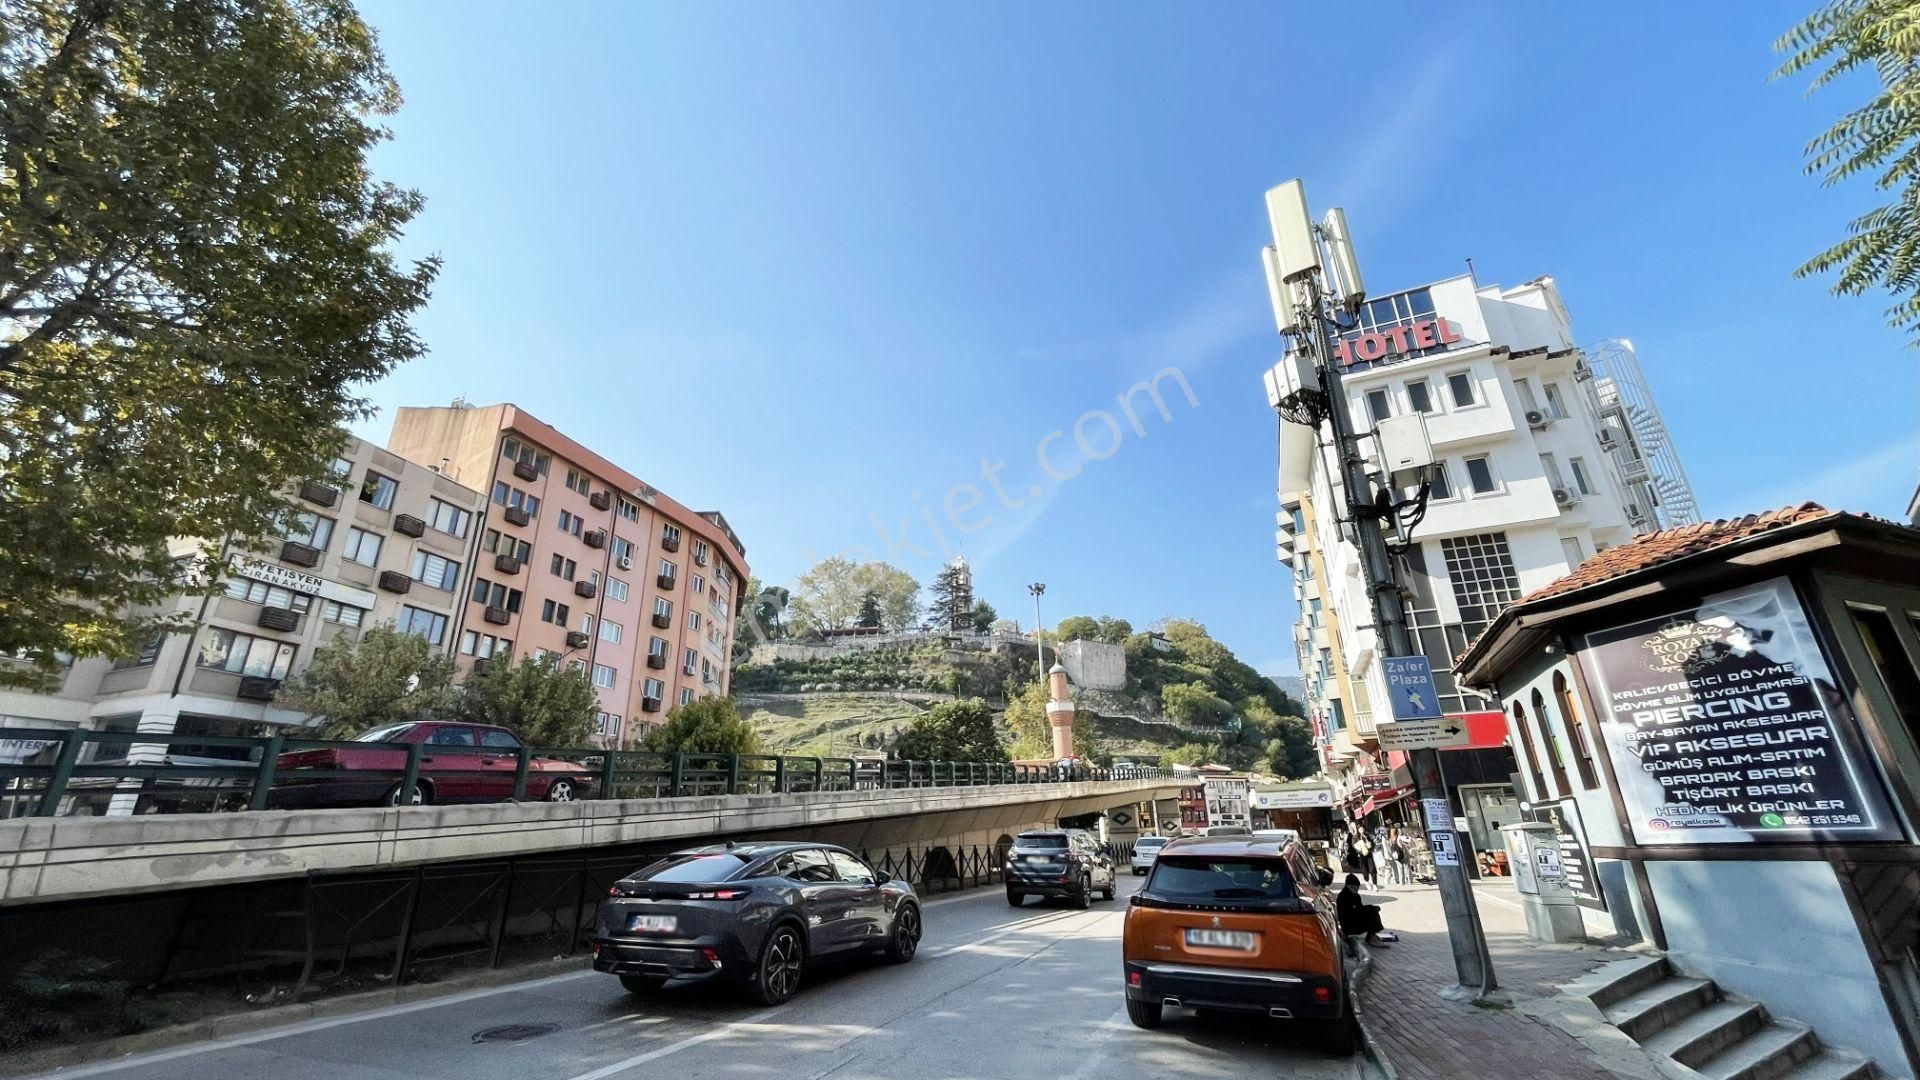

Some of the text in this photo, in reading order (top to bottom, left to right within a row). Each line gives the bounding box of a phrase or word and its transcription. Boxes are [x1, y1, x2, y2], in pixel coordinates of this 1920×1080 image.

[1386, 661, 1425, 673] Zafer
[1728, 664, 1795, 682] DÖVME
[1390, 675, 1428, 686] Plaza
[1613, 699, 1662, 713] DÖVME
[1704, 676, 1809, 699] UYGULAMASI
[1633, 691, 1791, 727] PIERCING
[1626, 710, 1825, 741] BAY-BAYAN AKSESUAR
[1627, 726, 1830, 758] VİP AKSESUAR
[1643, 747, 1826, 772] GÜMÜŞ ALIM-SATIM
[1660, 765, 1816, 786] BARDAK BASKI
[1672, 782, 1815, 801] TİŞÖRT BASKI
[1656, 799, 1845, 816] HEDİYELİK ÜRÜNLER
